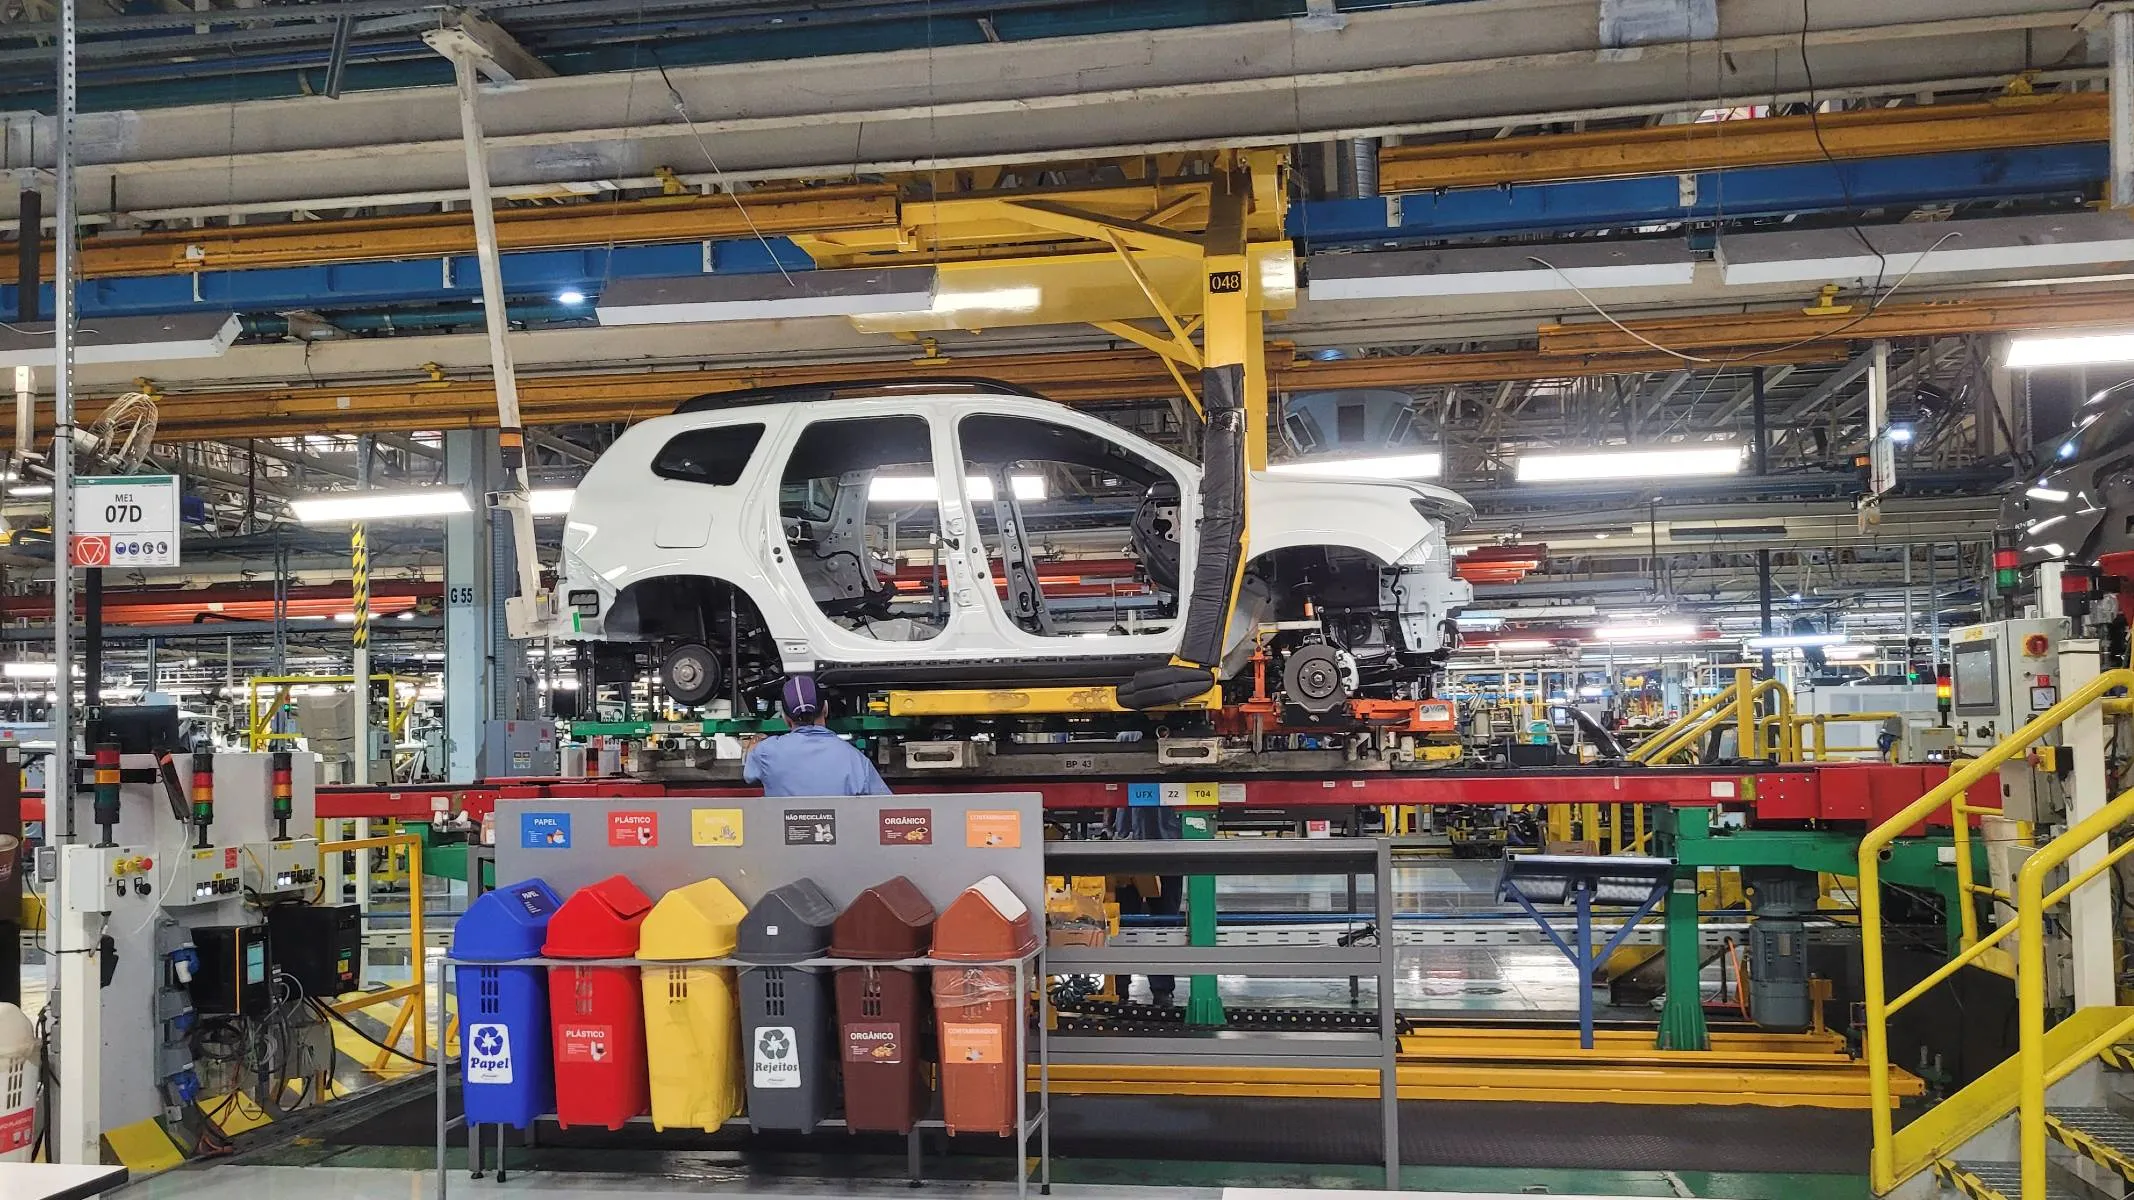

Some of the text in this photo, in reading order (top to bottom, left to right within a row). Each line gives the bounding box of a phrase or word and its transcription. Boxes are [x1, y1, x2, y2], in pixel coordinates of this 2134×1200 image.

[1212, 275, 1239, 290] 048
[115, 494, 133, 502] ME1
[105, 505, 142, 523] 07D
[450, 588, 473, 603] G 55
[534, 818, 557, 826] PAPEL
[614, 815, 651, 824] PLÁSTICO
[884, 816, 926, 825] ORGÂNICO
[566, 1029, 605, 1038] PLÁSTICO
[850, 1031, 894, 1040] ORGÂNICO
[471, 1057, 509, 1071] Papel
[755, 1062, 798, 1073] Rejeitos
